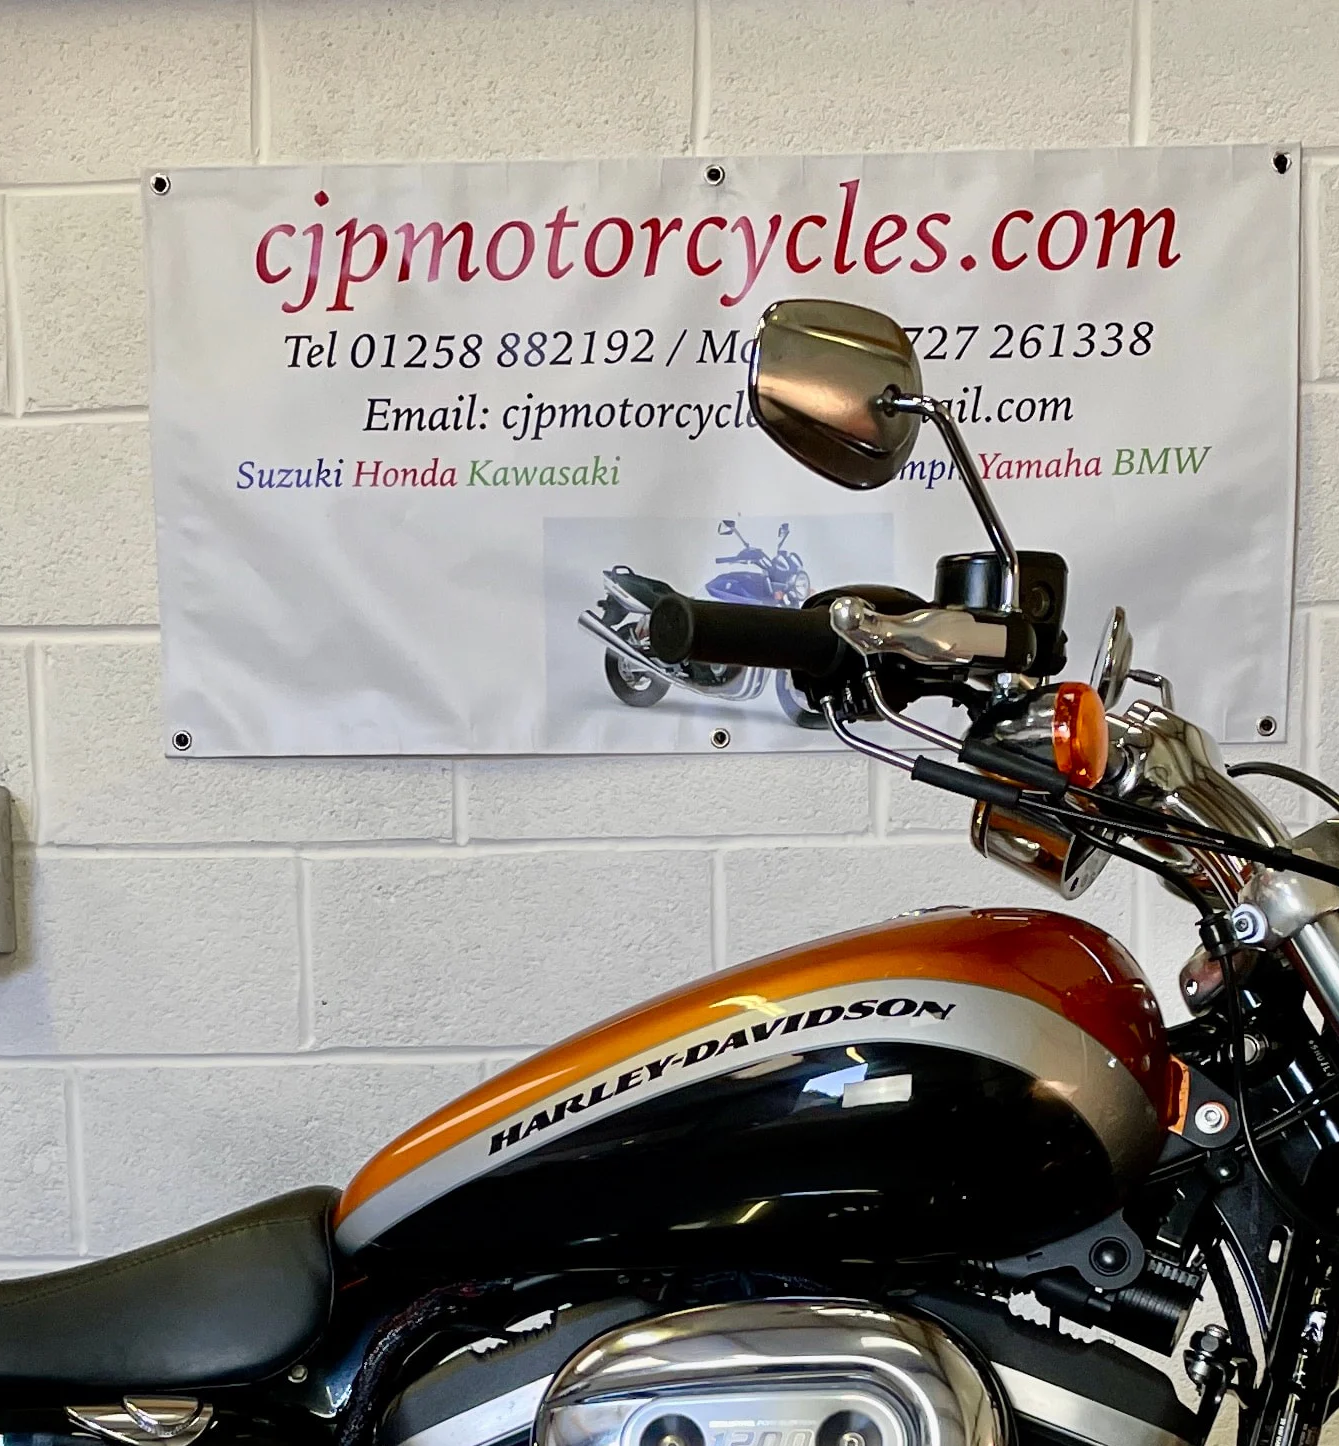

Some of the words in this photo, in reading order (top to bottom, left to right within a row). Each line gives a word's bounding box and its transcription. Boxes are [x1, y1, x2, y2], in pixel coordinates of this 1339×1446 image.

[256, 178, 1181, 314] cjpmotorcycles.com
[284, 330, 338, 368] Tel
[351, 333, 483, 369] 01258
[497, 329, 655, 368] 882192
[903, 325, 979, 360] 727
[989, 321, 1154, 360] 261338
[363, 392, 489, 433] Email:
[236, 457, 344, 491] Suzuki
[353, 459, 458, 490] Honda
[466, 455, 622, 488] Kawasaki
[978, 447, 1102, 480] Yamaha
[1112, 445, 1212, 477] BMW
[488, 998, 957, 1156] HARLEY-DAVIDSON
